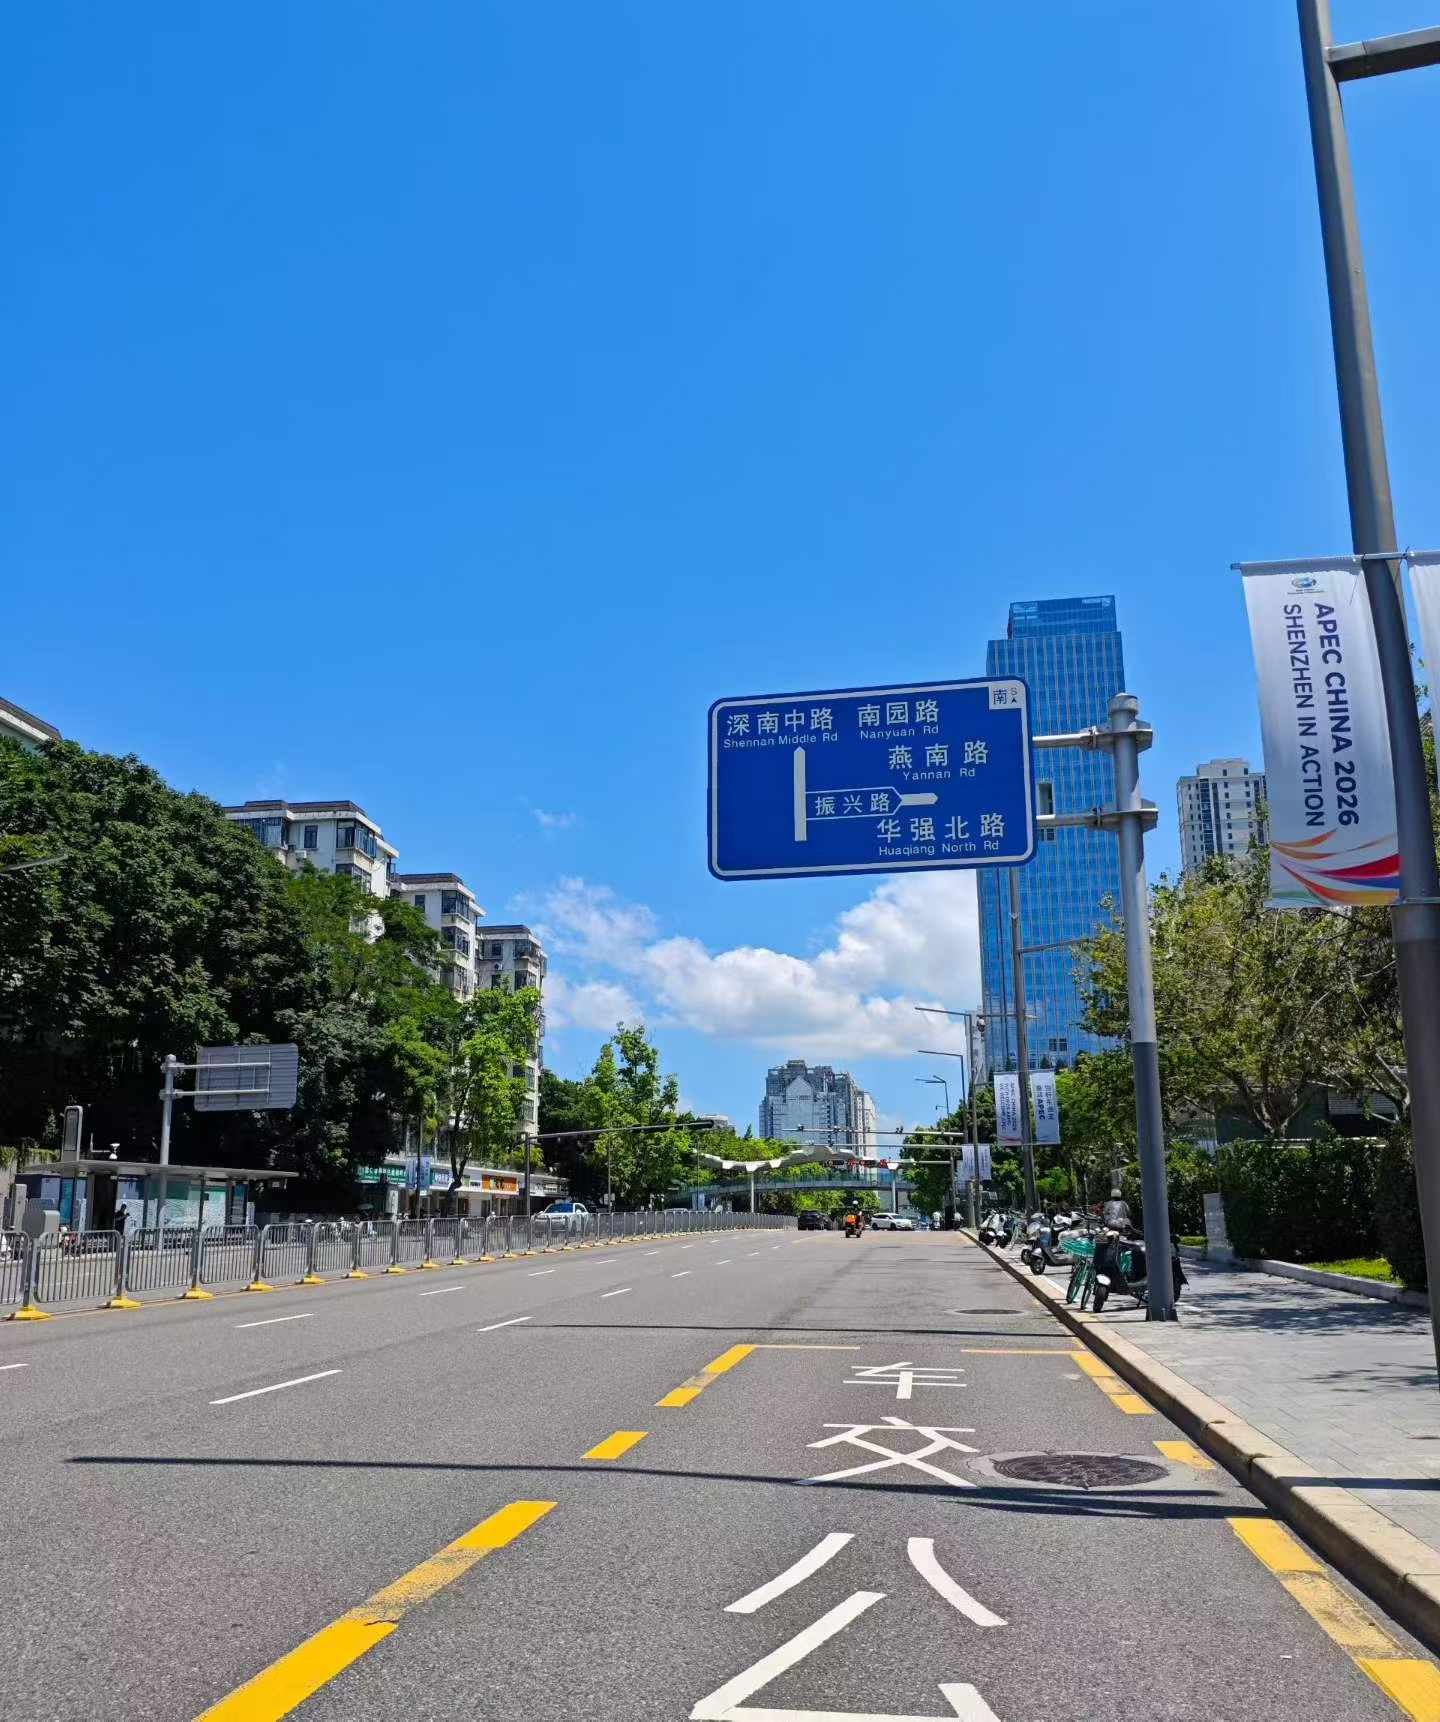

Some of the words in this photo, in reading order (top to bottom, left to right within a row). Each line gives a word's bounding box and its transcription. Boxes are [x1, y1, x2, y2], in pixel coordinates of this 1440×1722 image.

[1314, 603, 1343, 664] APEC
[1283, 604, 1315, 708] SHENZHEN
[992, 688, 1008, 704] 南
[1011, 687, 1018, 695] S
[726, 707, 833, 736] 深南中路
[857, 699, 939, 728] 南园路
[1297, 716, 1318, 736] IN
[1325, 672, 1353, 753] CHINA
[723, 737, 775, 748] Shennan
[778, 734, 817, 745] Middle
[822, 731, 838, 742] Rd
[860, 727, 915, 740] Nanyuan
[923, 725, 939, 735] Rd
[887, 740, 988, 770] 燕南路
[902, 769, 951, 781] Yannan
[960, 767, 976, 777] Rd
[1300, 744, 1325, 826] ACTION
[815, 791, 890, 816] 振兴路
[1334, 760, 1360, 826] 2026
[877, 812, 1005, 843] 华强北路
[879, 843, 935, 857] Huaqiang
[942, 841, 976, 853] North
[984, 840, 999, 851] Rd
